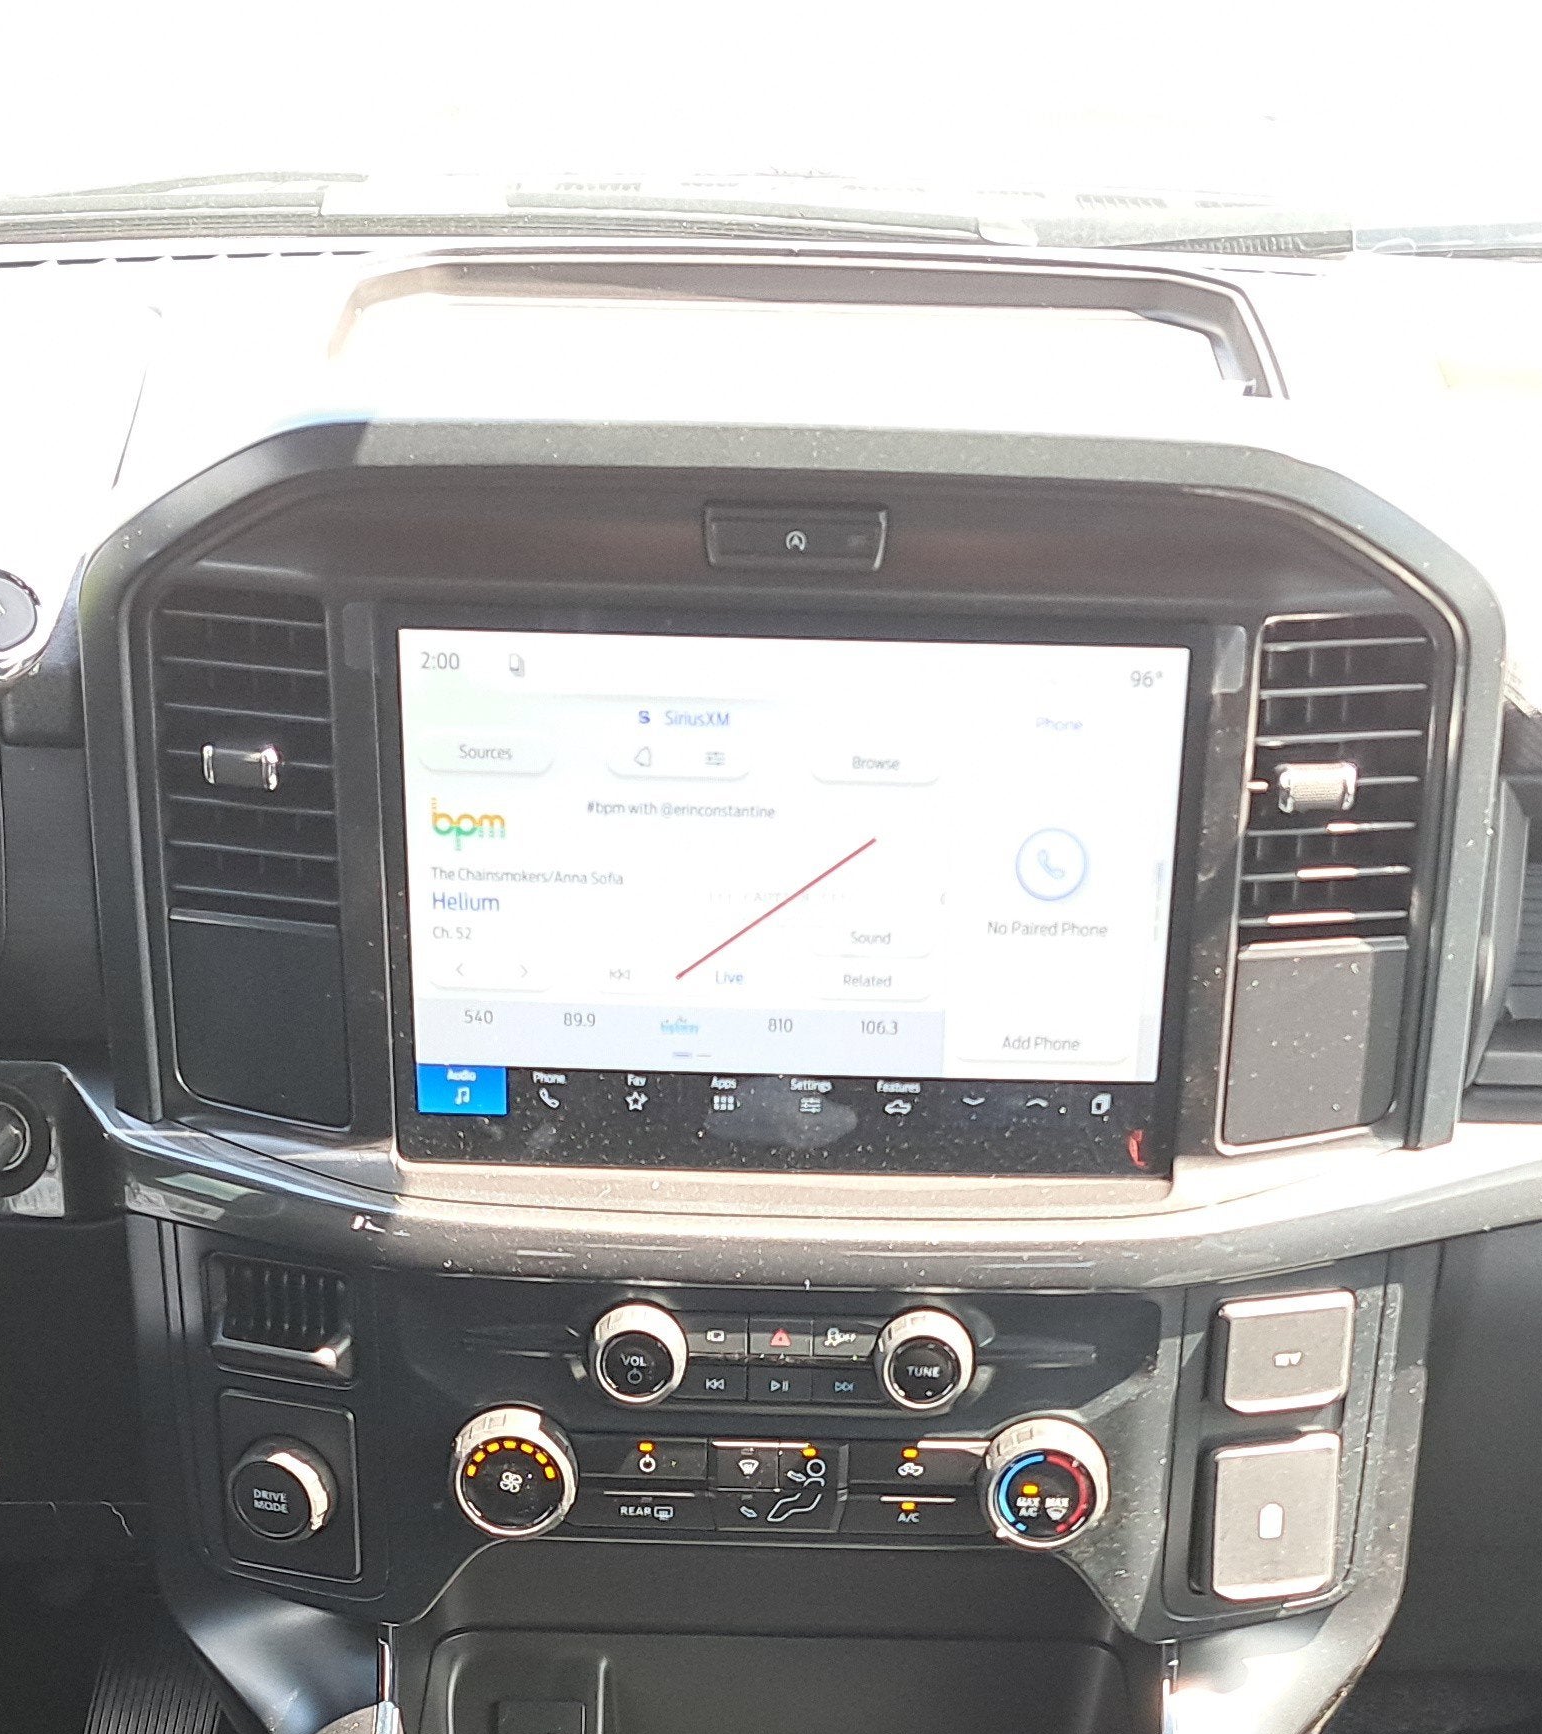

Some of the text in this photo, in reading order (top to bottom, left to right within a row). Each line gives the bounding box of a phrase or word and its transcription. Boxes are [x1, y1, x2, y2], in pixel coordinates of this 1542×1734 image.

[420, 651, 460, 670] 2:00
[665, 710, 730, 726] SiriusXM
[1036, 716, 1083, 730] Phone
[459, 744, 512, 761] Sources
[852, 756, 900, 770] Browse
[628, 802, 657, 815] with
[431, 798, 506, 850] bpm
[432, 867, 455, 881] The
[591, 872, 623, 885] Sofia
[432, 893, 500, 911] Helium
[456, 927, 472, 940] 52
[987, 921, 1108, 937] No Paired Phone
[851, 931, 891, 945] Sound
[715, 971, 743, 984] Live
[843, 974, 892, 988] Related
[464, 1010, 493, 1025] 540
[563, 1012, 596, 1027] 89.9
[768, 1018, 793, 1033] 810
[861, 1020, 898, 1035] 106.3
[1002, 1036, 1080, 1051] Add Phone
[620, 1356, 647, 1367] VOL
[906, 1365, 940, 1378] TUNE
[253, 1488, 287, 1502] DRIVE
[254, 1500, 289, 1514] MODE
[620, 1506, 652, 1517] REAR
[897, 1513, 919, 1523] A/C
